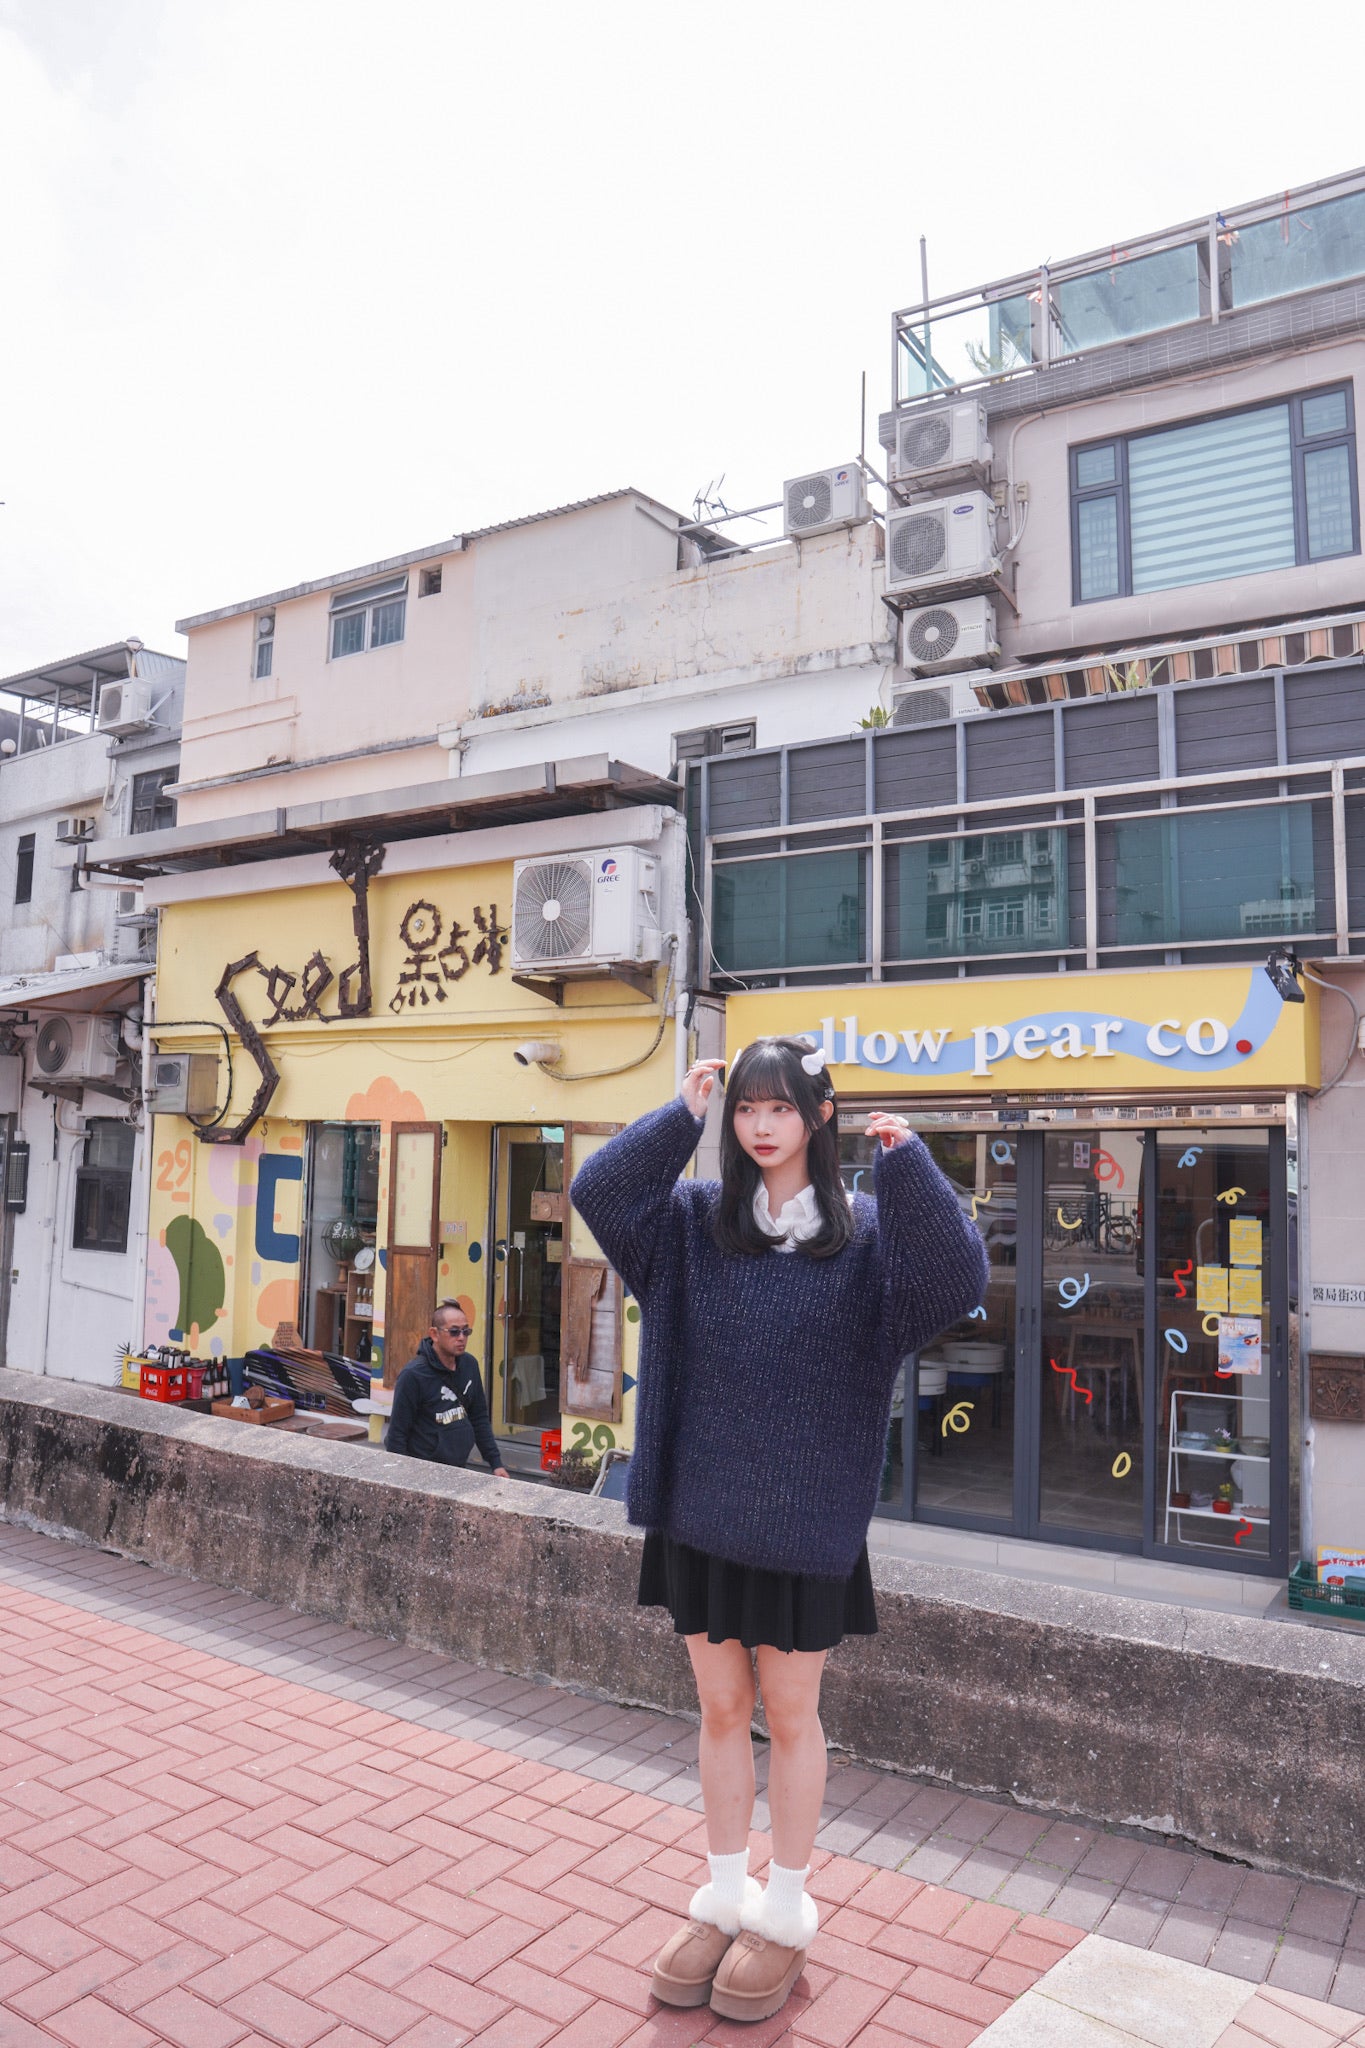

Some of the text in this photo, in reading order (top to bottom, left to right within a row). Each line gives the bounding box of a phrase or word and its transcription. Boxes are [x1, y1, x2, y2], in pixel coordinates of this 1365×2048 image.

[597, 874, 621, 884] GREE
[757, 1015, 1254, 1077] llow pear co.
[156, 1138, 192, 1192] 29
[571, 1421, 616, 1470] 29
